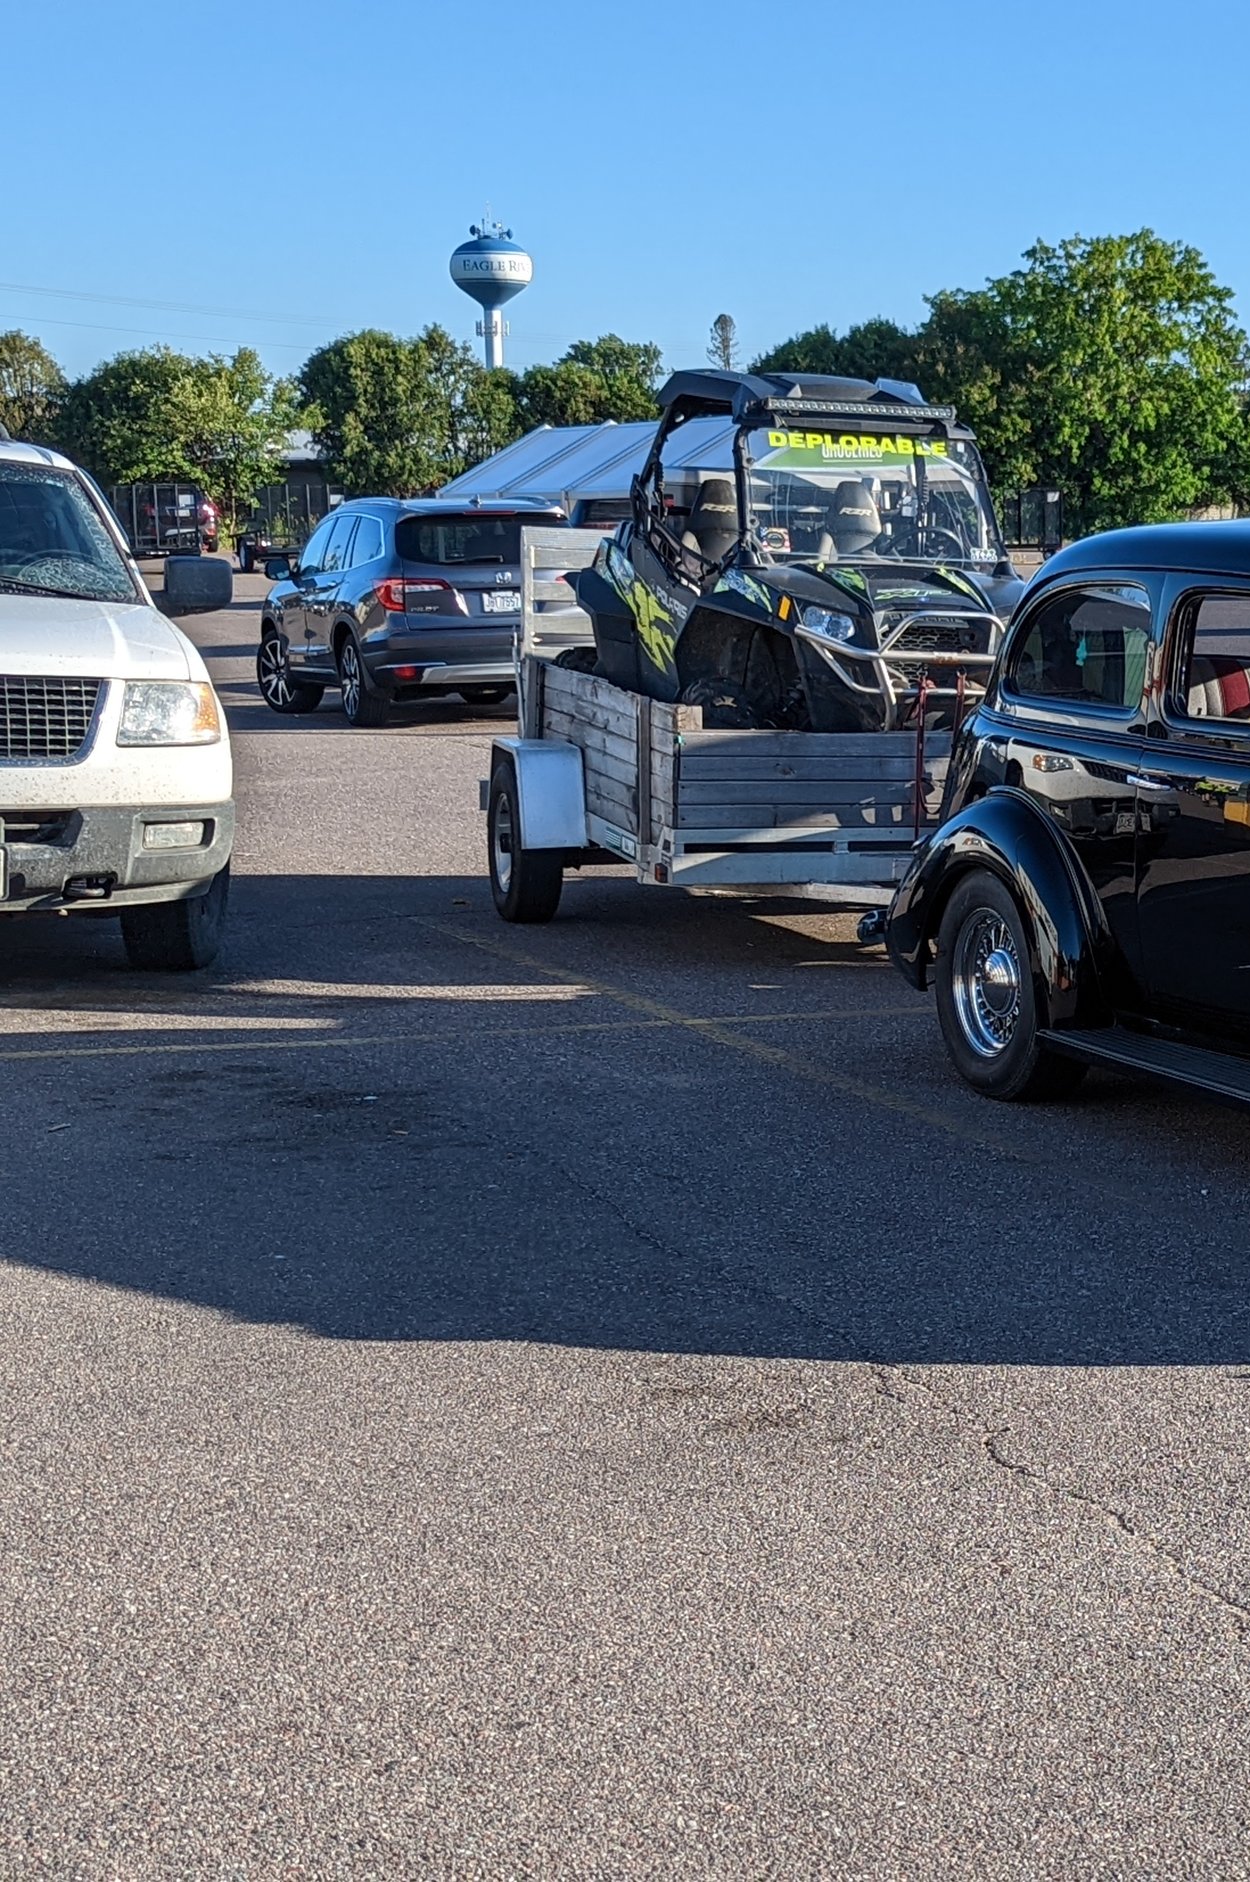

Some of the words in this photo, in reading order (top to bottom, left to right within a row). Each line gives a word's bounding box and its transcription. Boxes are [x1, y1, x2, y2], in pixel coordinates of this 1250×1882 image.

[463, 259, 505, 271] EAGLE
[768, 431, 948, 457] DEPLORABLE
[656, 584, 688, 620] POLARIS
